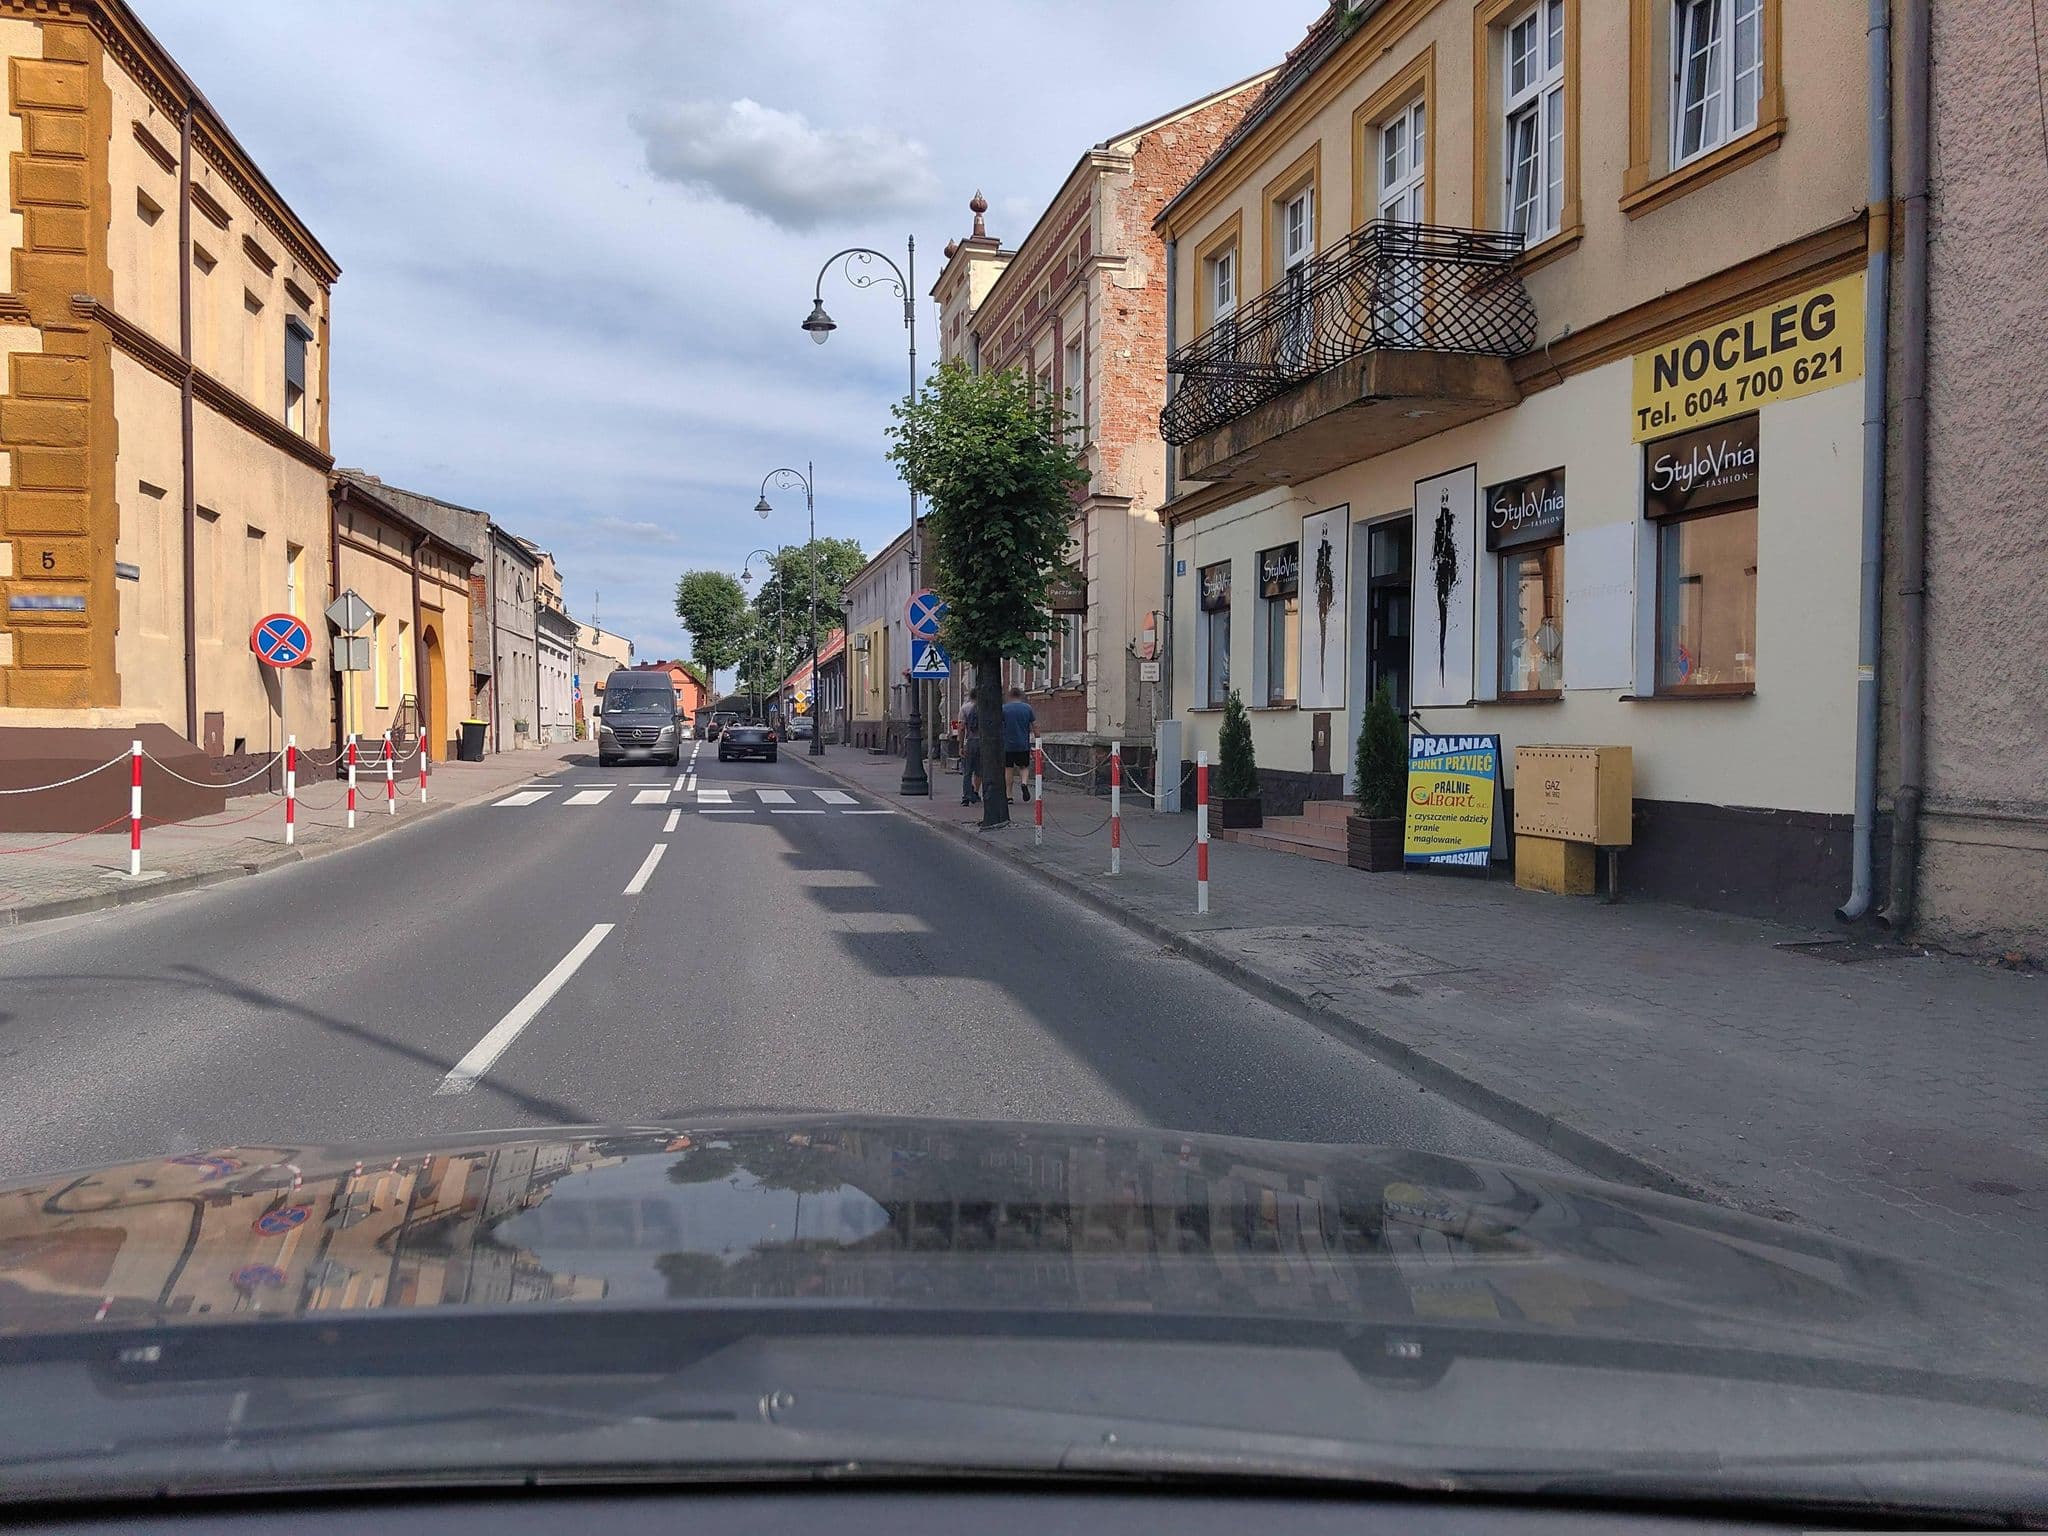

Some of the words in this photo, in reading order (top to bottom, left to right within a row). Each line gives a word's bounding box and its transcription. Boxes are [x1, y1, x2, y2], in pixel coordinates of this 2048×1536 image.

[1653, 293, 1836, 394] NOCLEG
[1637, 401, 1677, 431] Tel.
[1684, 383, 1728, 417] 604
[1736, 365, 1784, 402] 700
[1793, 346, 1843, 385] 621
[1651, 440, 1755, 492] StyloVnia
[1706, 472, 1748, 488] FASHION
[1491, 487, 1565, 530] StyloVnia
[1531, 516, 1561, 528] FASHION
[42, 551, 56, 570] 5
[1412, 737, 1494, 758] PRALNIA
[1411, 758, 1445, 770] PUNKT
[1446, 752, 1493, 774] PRZYJĘĆ
[1434, 780, 1471, 794] PRALNIE
[1544, 780, 1560, 791] GAZ
[1414, 813, 1458, 822] czyszczenie
[1459, 814, 1489, 825] odzieży
[1413, 824, 1440, 832] pranie
[1413, 835, 1462, 845] maglowanie
[1429, 851, 1489, 866] ZAPRASZAMY
